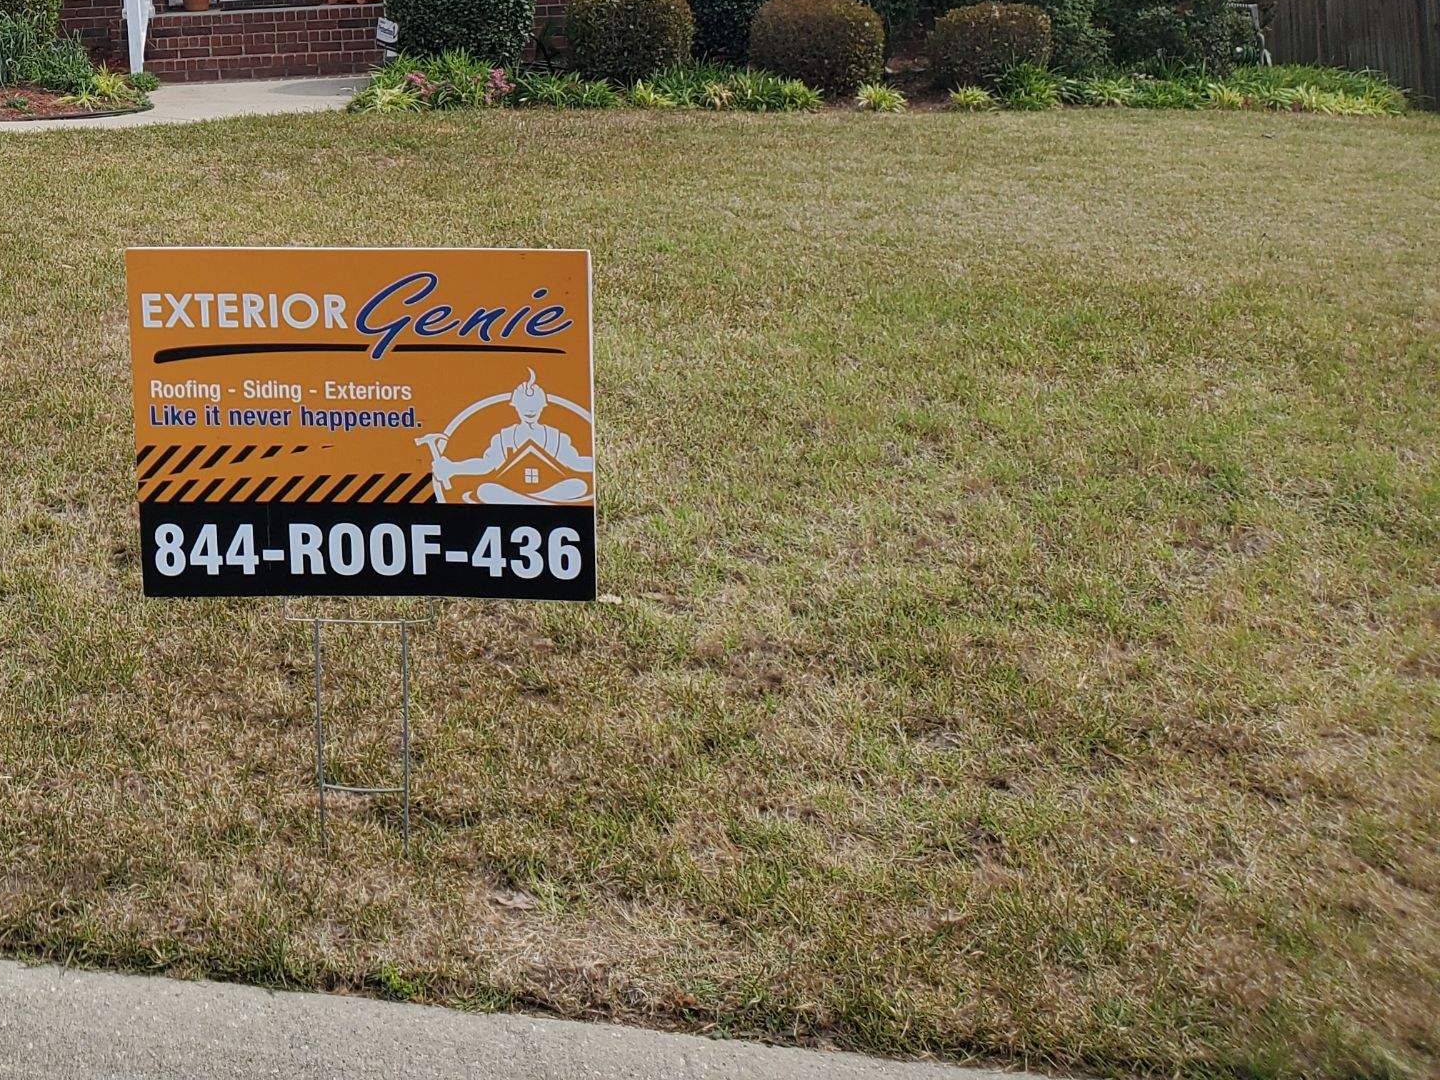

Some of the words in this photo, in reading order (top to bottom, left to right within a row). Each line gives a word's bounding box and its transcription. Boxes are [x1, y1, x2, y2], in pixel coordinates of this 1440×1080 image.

[141, 292, 349, 329] EXTERIOR
[354, 271, 573, 359] Genie
[150, 380, 221, 402] Roofing
[243, 380, 302, 402] Siding
[325, 381, 412, 401] Exteriors
[149, 404, 197, 427] Like
[204, 404, 221, 427] it
[229, 407, 292, 428] never
[300, 404, 423, 432] happened.
[154, 522, 582, 580] 844-ROOF-436
